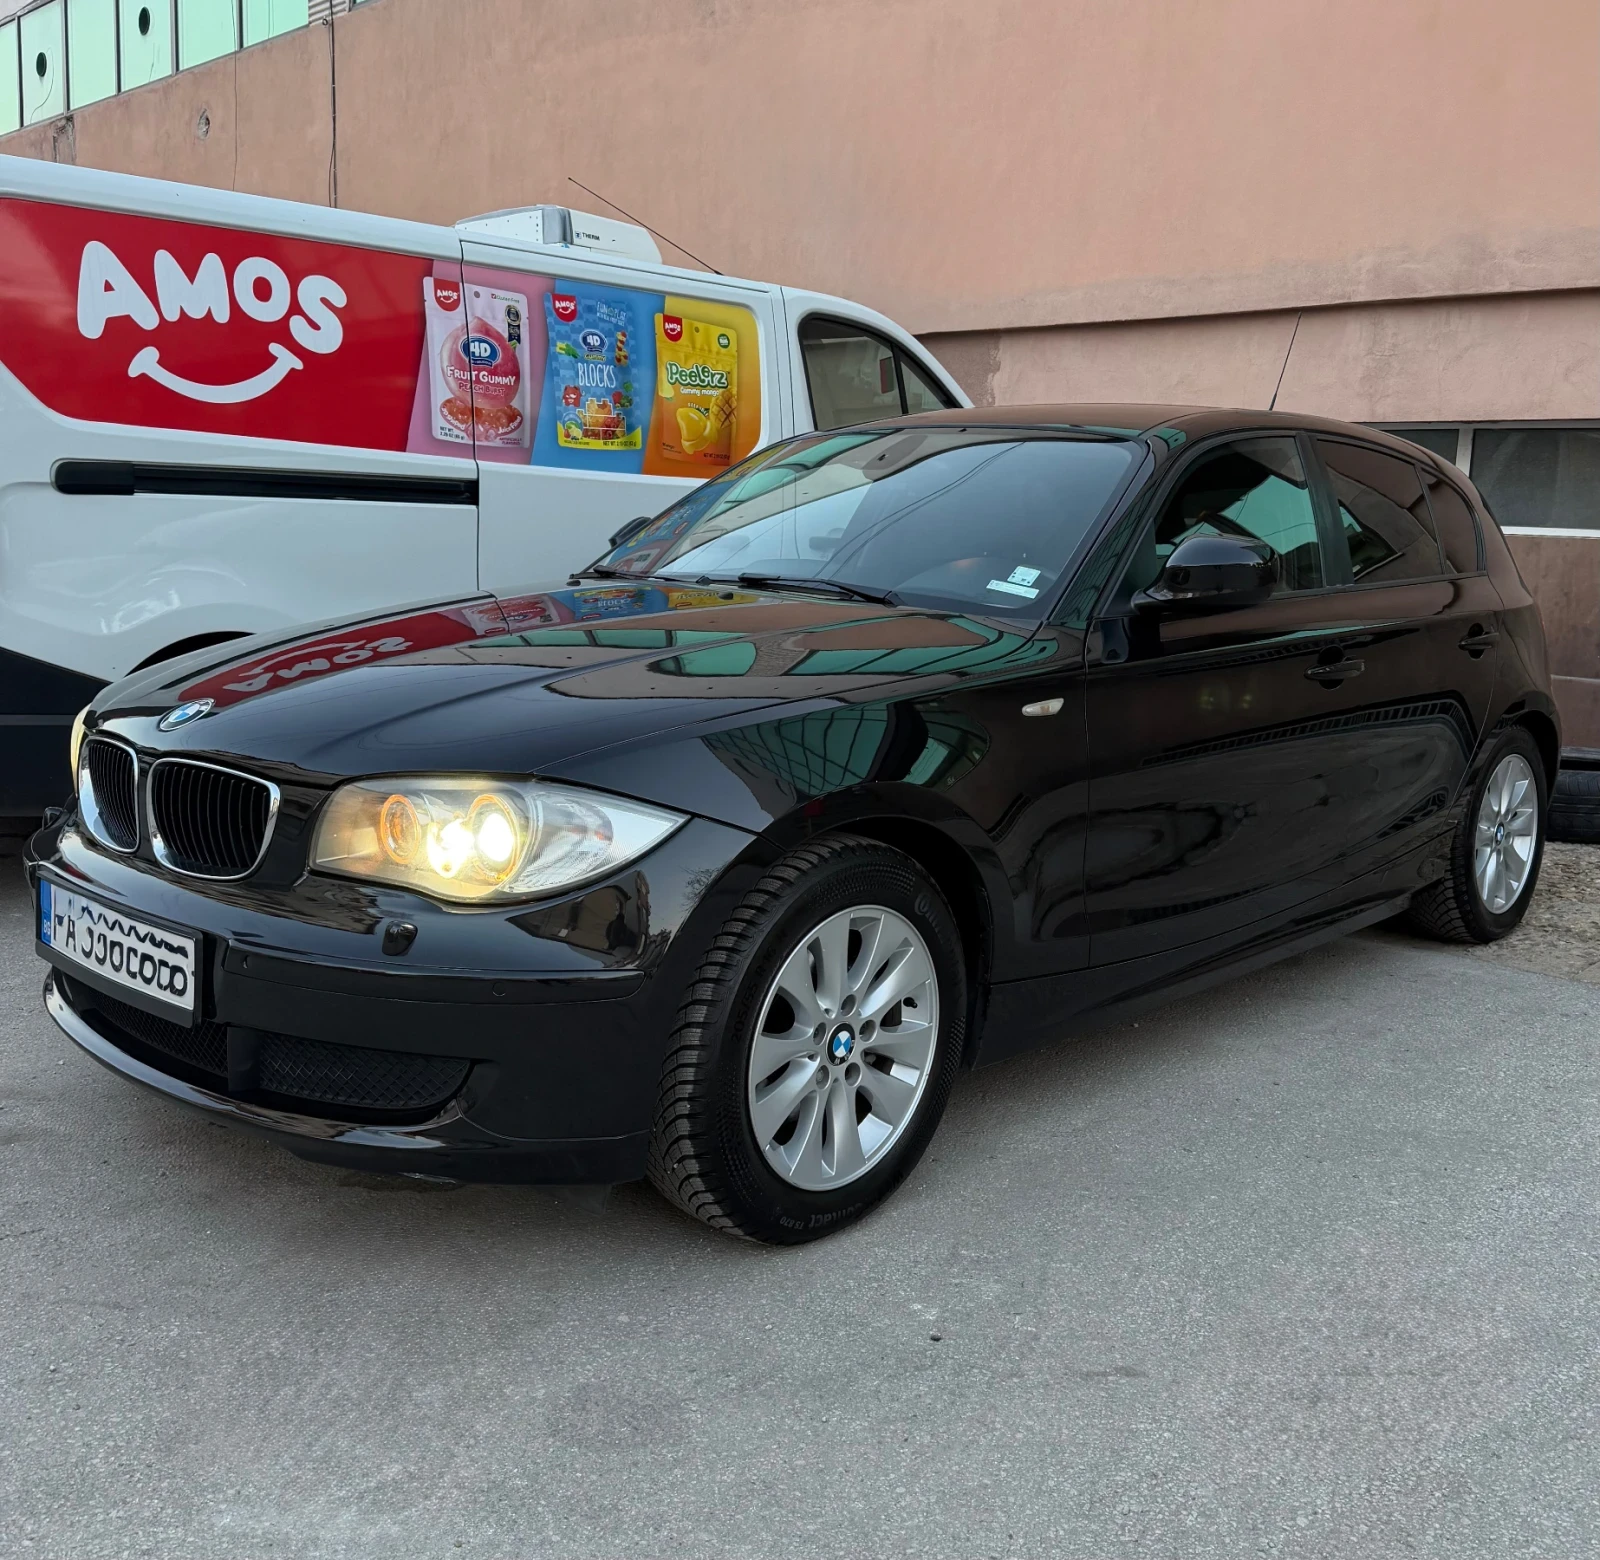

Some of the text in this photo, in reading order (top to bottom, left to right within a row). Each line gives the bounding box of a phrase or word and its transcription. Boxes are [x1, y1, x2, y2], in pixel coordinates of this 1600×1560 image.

[77, 240, 348, 355] AMOS
[437, 289, 459, 299] AMOS
[555, 300, 576, 310] AMOS
[665, 322, 681, 332] AMOS
[587, 334, 601, 346] 4D
[470, 341, 491, 358] 4D
[447, 366, 516, 386] FRUIT GUMMY
[578, 362, 617, 388] BLOCKS
[43, 918, 51, 935] BG
